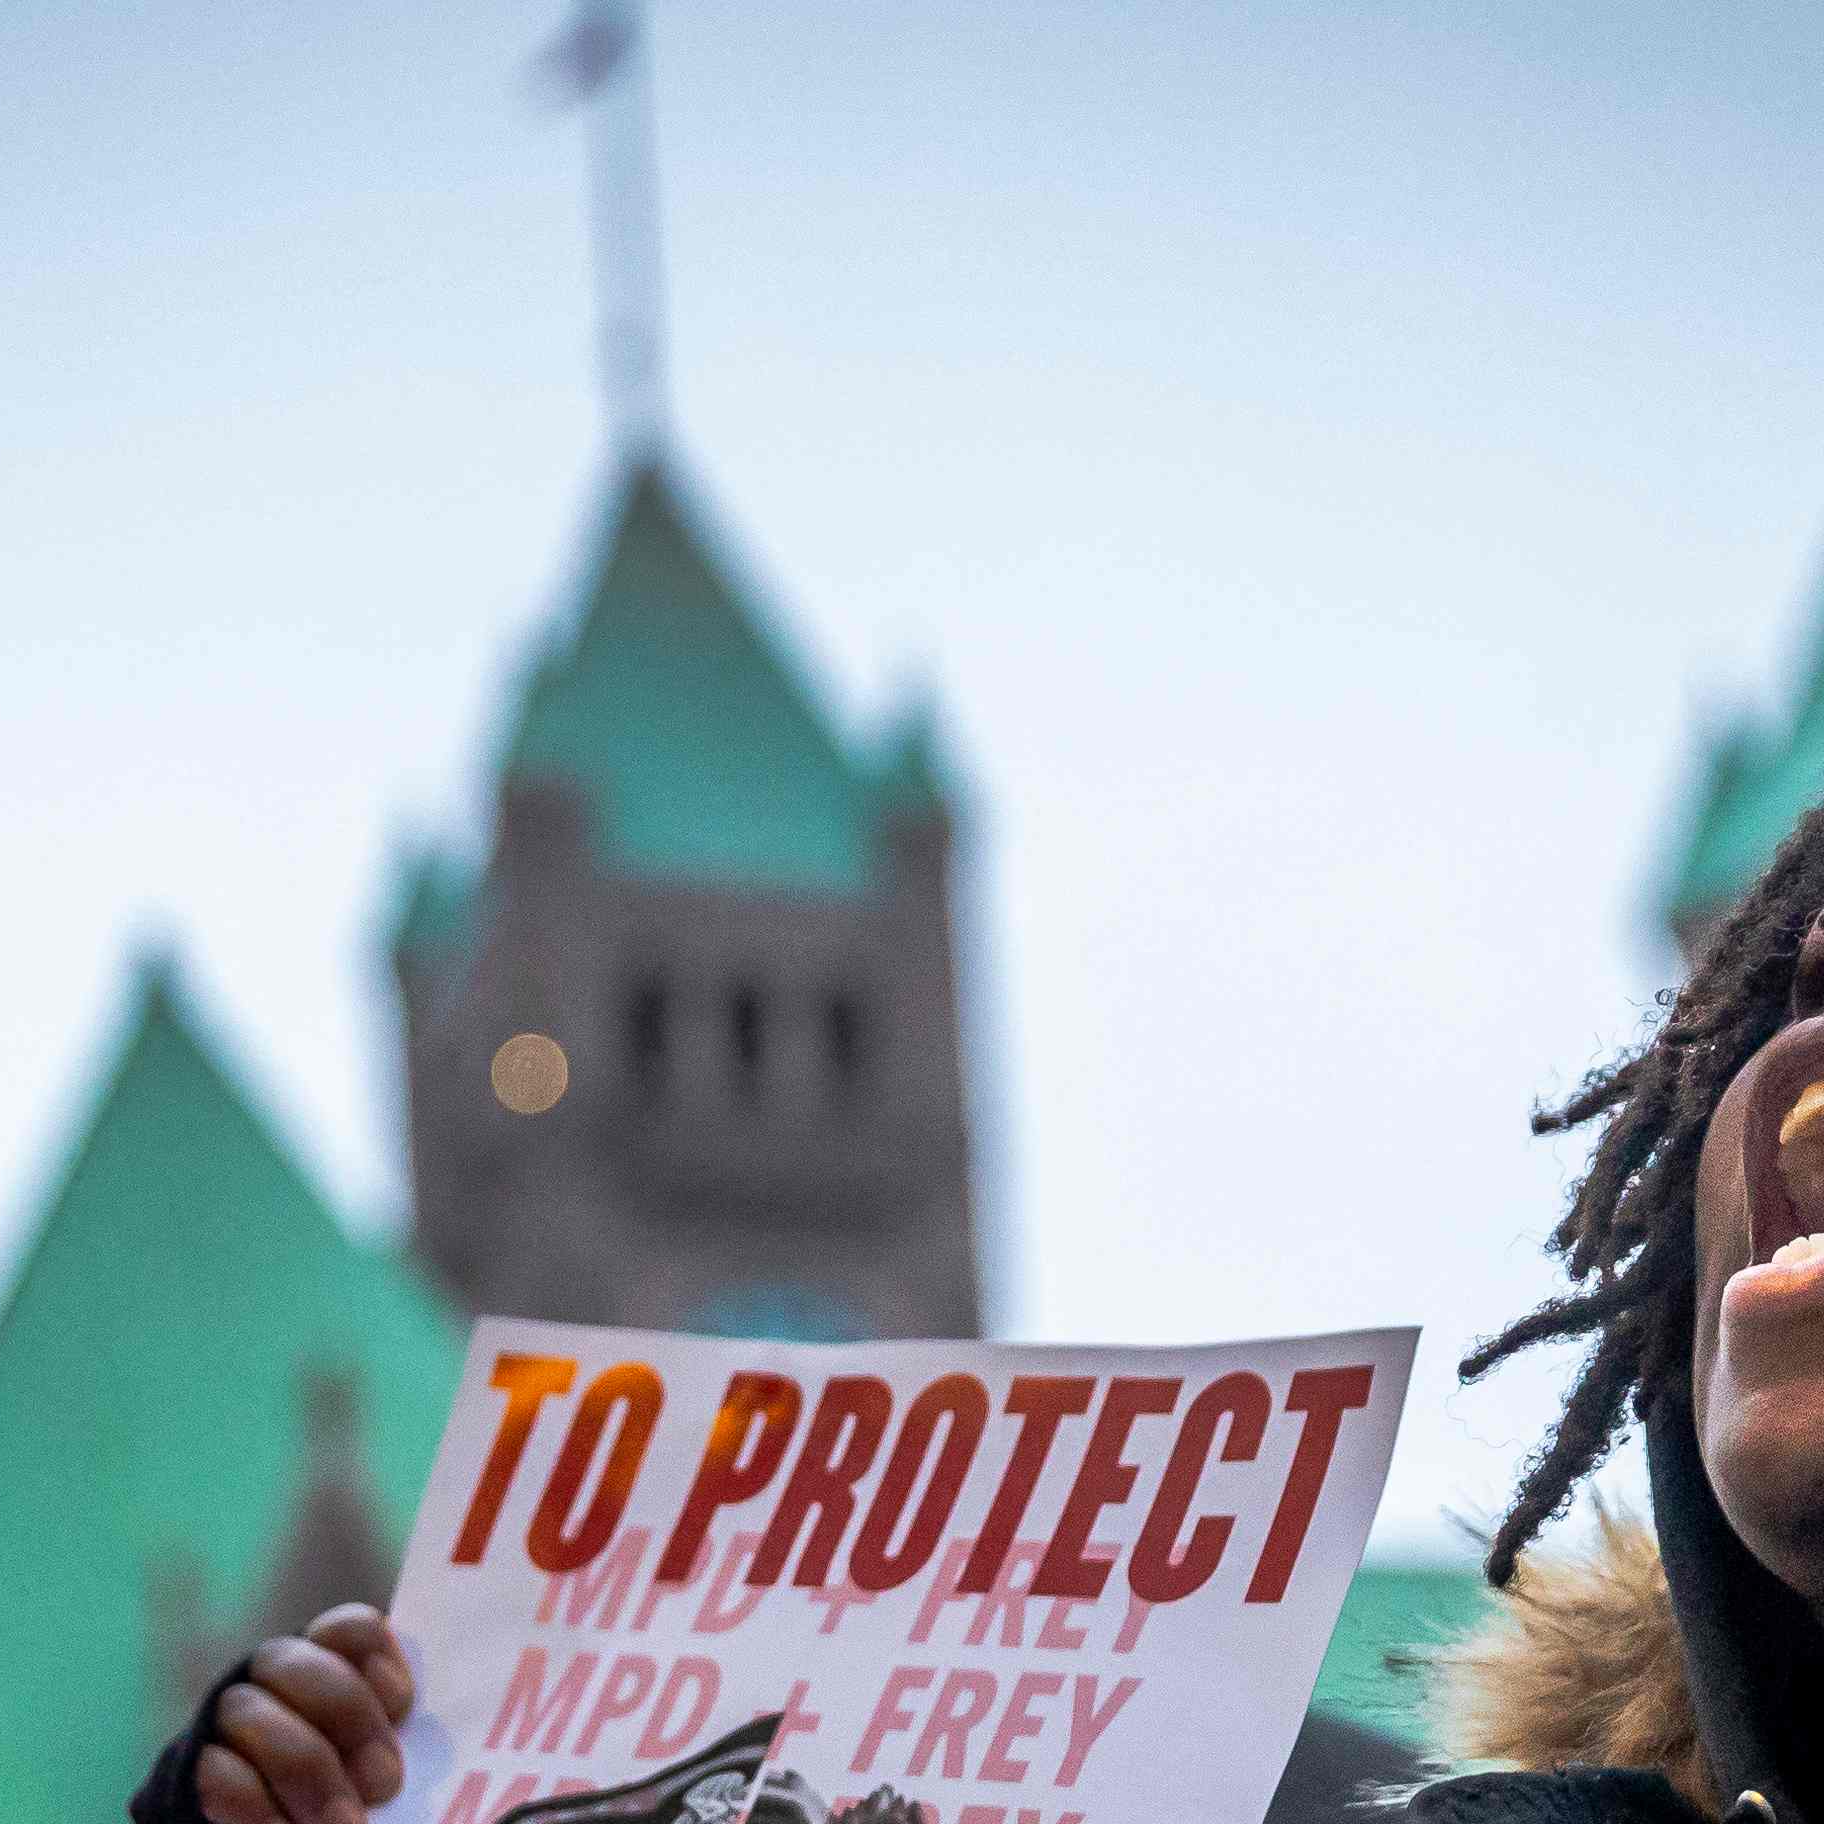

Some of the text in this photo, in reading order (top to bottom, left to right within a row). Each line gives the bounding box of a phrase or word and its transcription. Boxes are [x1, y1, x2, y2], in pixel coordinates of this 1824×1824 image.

[451, 1352, 1375, 1604] TO PROTECT
[484, 1646, 722, 1759] MPD
[849, 1665, 1145, 1788] FREY
